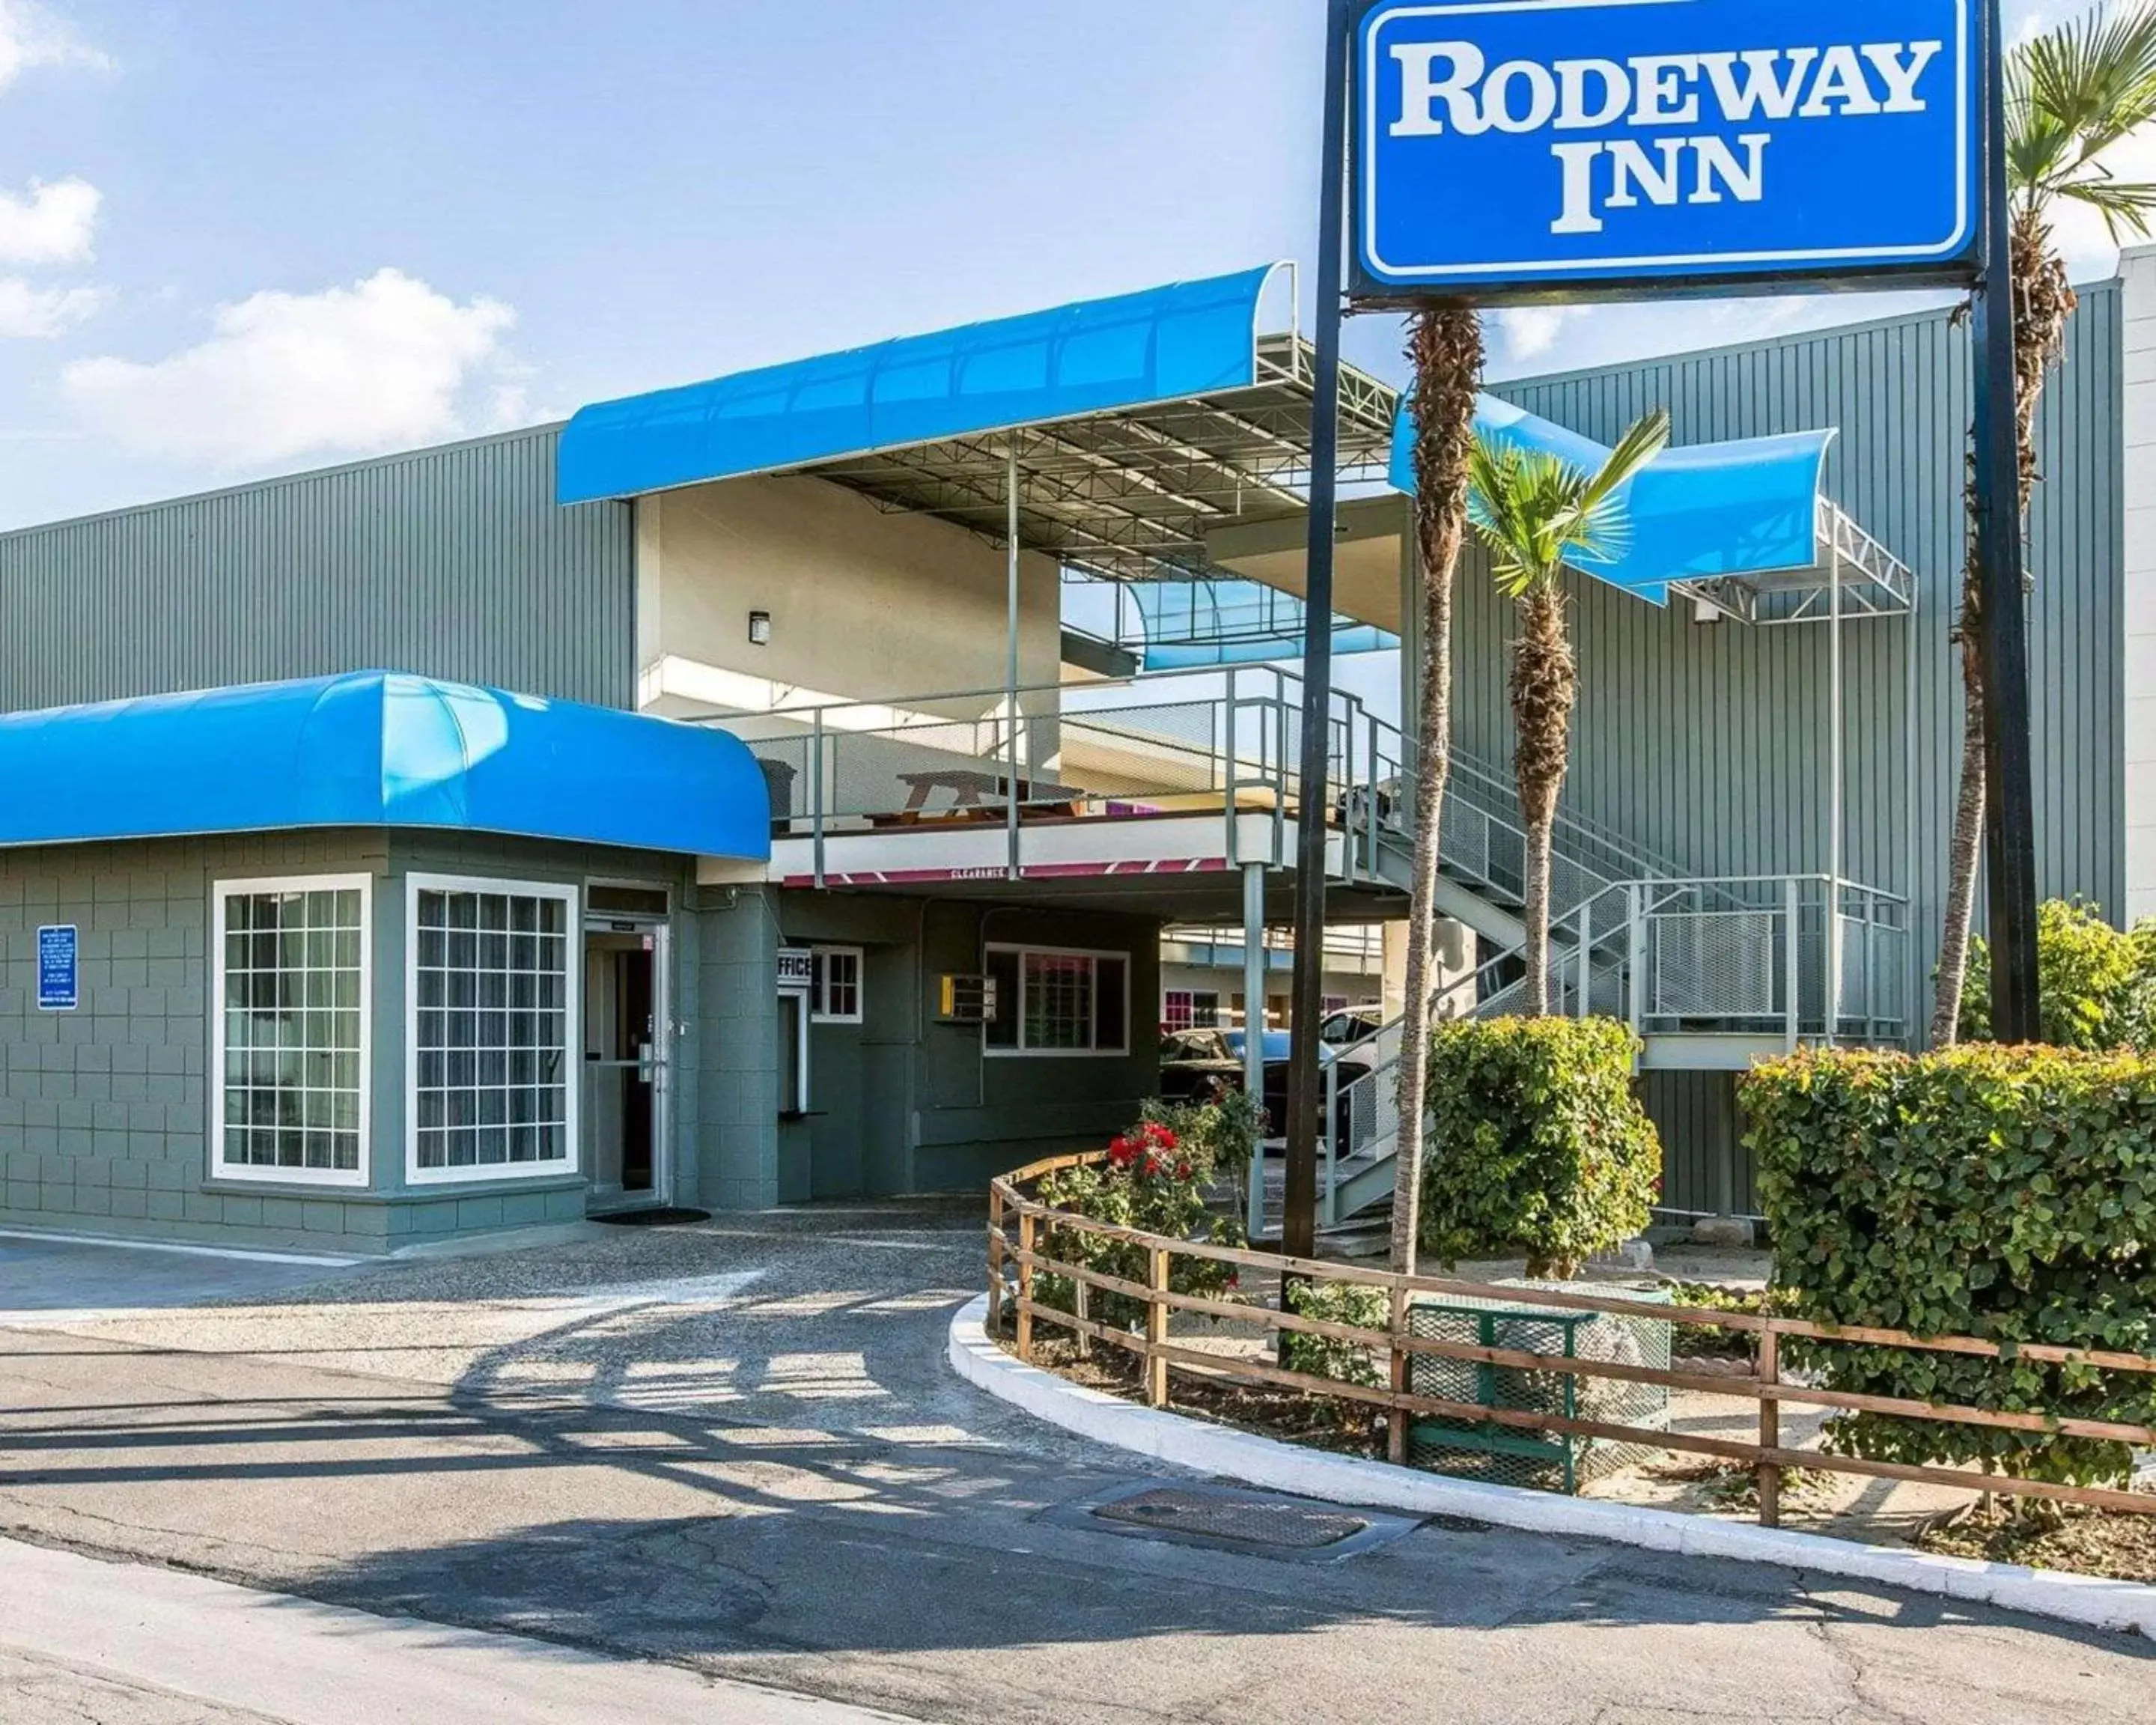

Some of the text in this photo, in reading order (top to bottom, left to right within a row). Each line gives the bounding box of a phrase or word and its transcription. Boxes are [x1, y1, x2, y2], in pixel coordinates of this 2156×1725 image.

[1389, 40, 1942, 137] RODEWAY
[1550, 133, 1770, 234] INN
[951, 868, 1005, 879] CLEARANCE
[778, 957, 811, 976] FFICE
